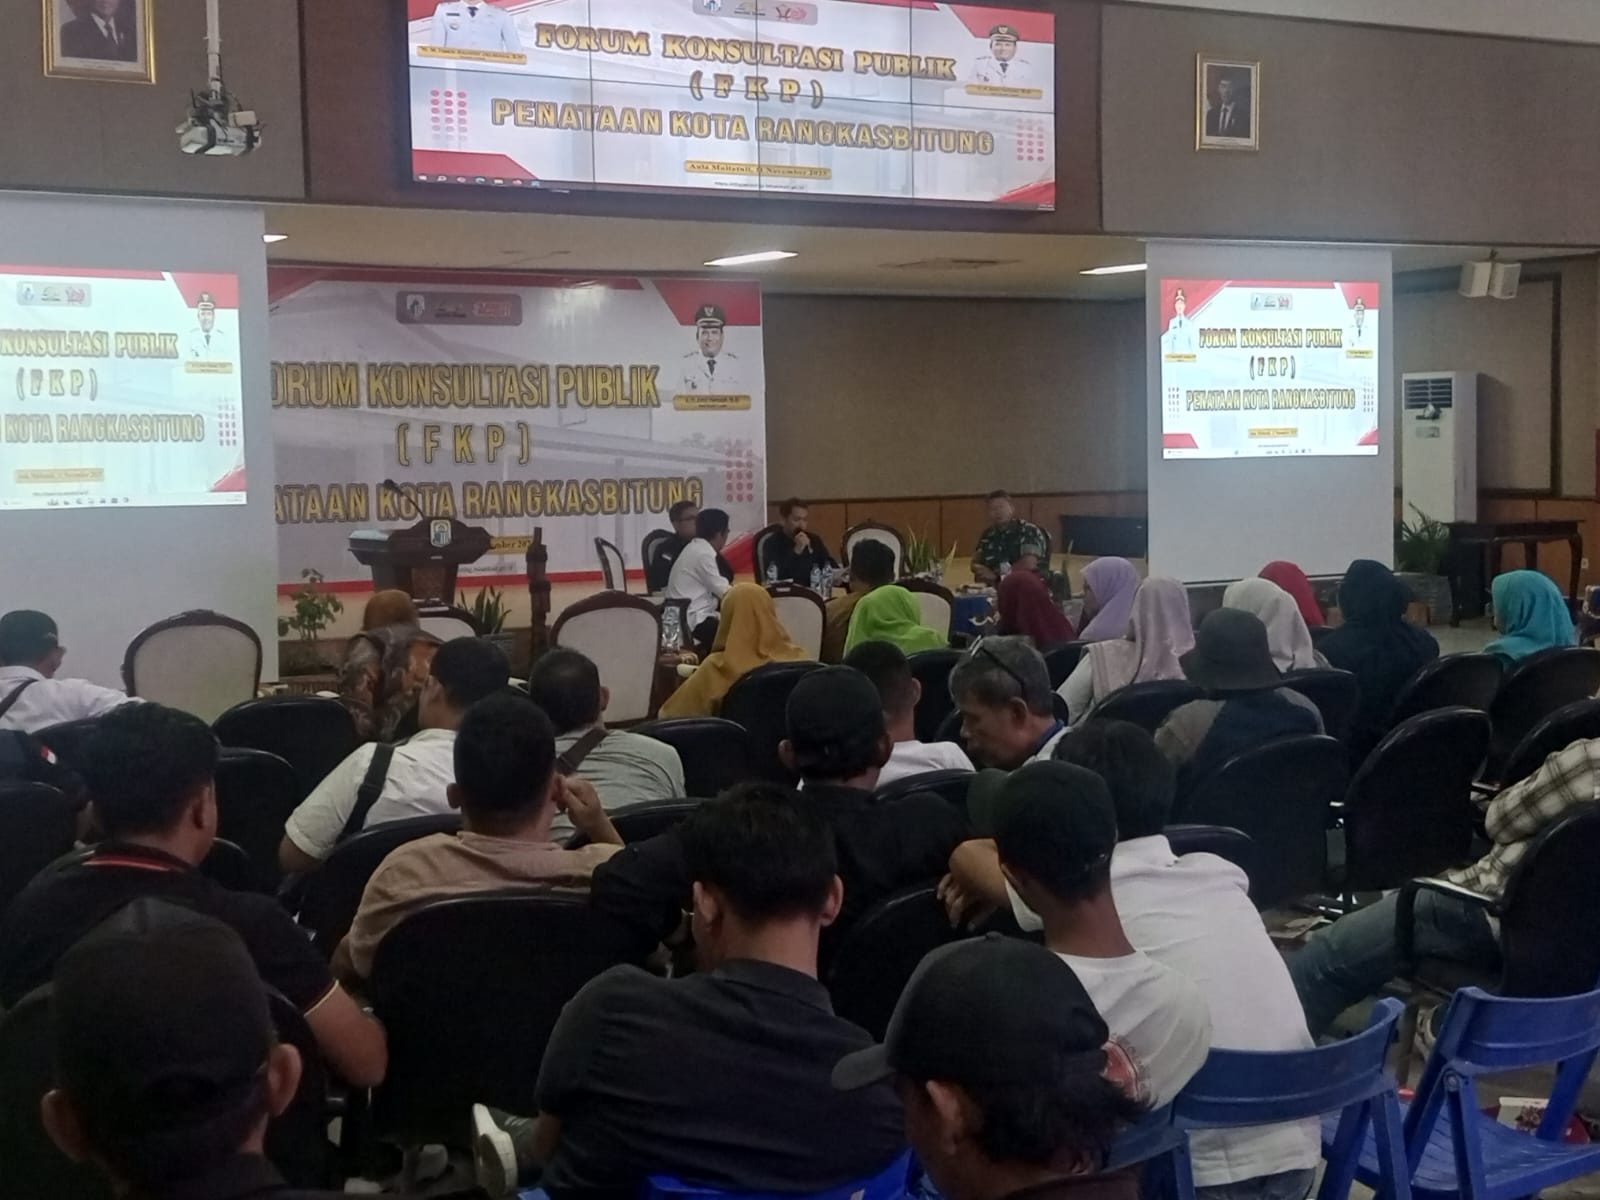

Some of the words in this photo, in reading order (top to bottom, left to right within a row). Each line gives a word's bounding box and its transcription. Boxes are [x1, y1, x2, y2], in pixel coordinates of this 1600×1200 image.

[535, 22, 650, 56] FORUM
[662, 34, 843, 71] KONSULTASI
[853, 51, 956, 81] PUBLIK
[491, 98, 662, 135] PENATAAN
[669, 110, 749, 140] KOTA
[755, 117, 994, 155] RANGKASBITUNG
[0, 329, 109, 357] KONSULTASI
[115, 332, 179, 359] PUBLIK
[1240, 328, 1302, 348] KONSULTASI
[1306, 328, 1343, 348] PUBLIK
[366, 362, 549, 409] KONSULTASI
[556, 365, 660, 409] PUBLIK
[1186, 389, 1241, 411] PENATAAN
[1243, 389, 1270, 410] KOTA
[4, 414, 53, 443] KOTA
[56, 414, 205, 443] RANGKASBITUNG
[376, 482, 457, 521] KOTA
[462, 476, 703, 520] RANGKASBITUNG
